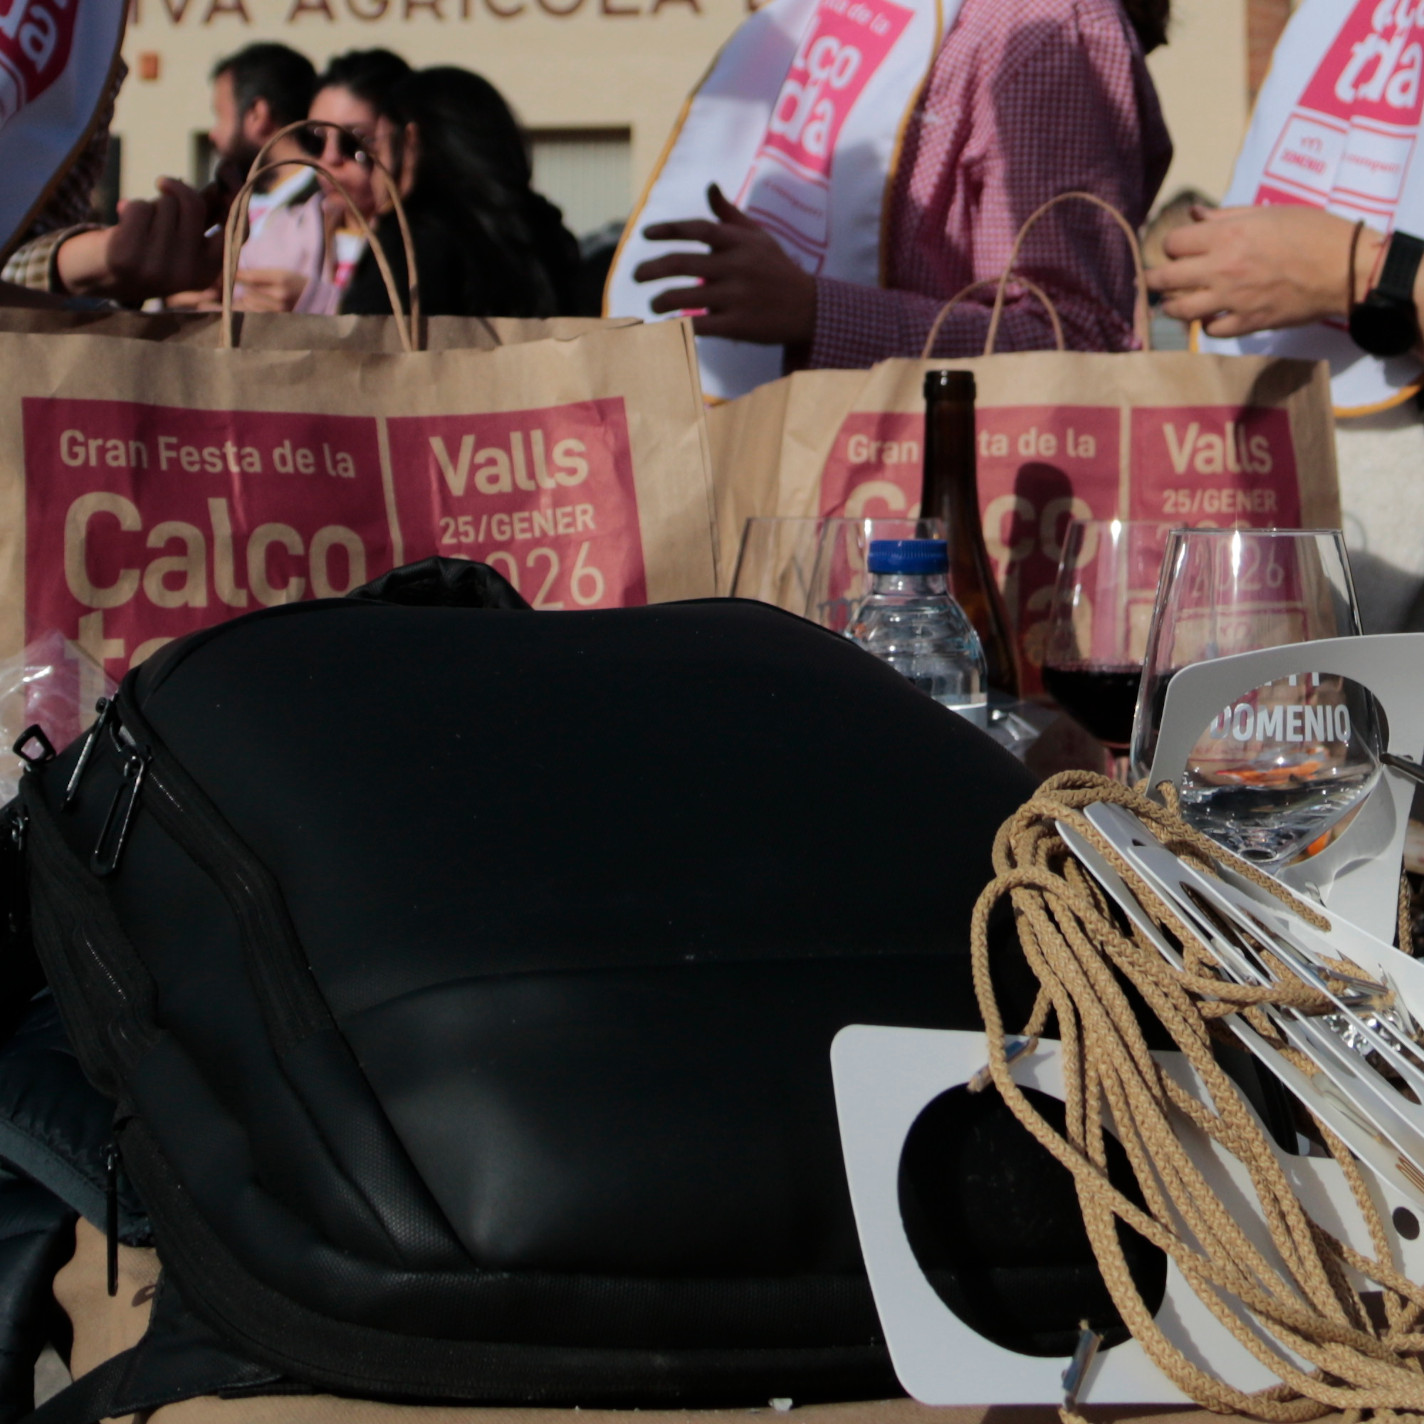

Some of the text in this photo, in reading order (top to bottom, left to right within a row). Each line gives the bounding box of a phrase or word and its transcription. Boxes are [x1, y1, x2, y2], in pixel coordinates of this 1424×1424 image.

[59, 429, 356, 478] Gran Festa de la
[429, 428, 590, 497] Valls
[847, 433, 920, 463] Gran
[1018, 426, 1057, 457] de
[1067, 427, 1096, 458] la
[1162, 422, 1272, 474] Valls
[1161, 489, 1278, 514] 25/GENER
[439, 502, 596, 545] 25/GENER
[1209, 702, 1351, 743] DOMENIO
